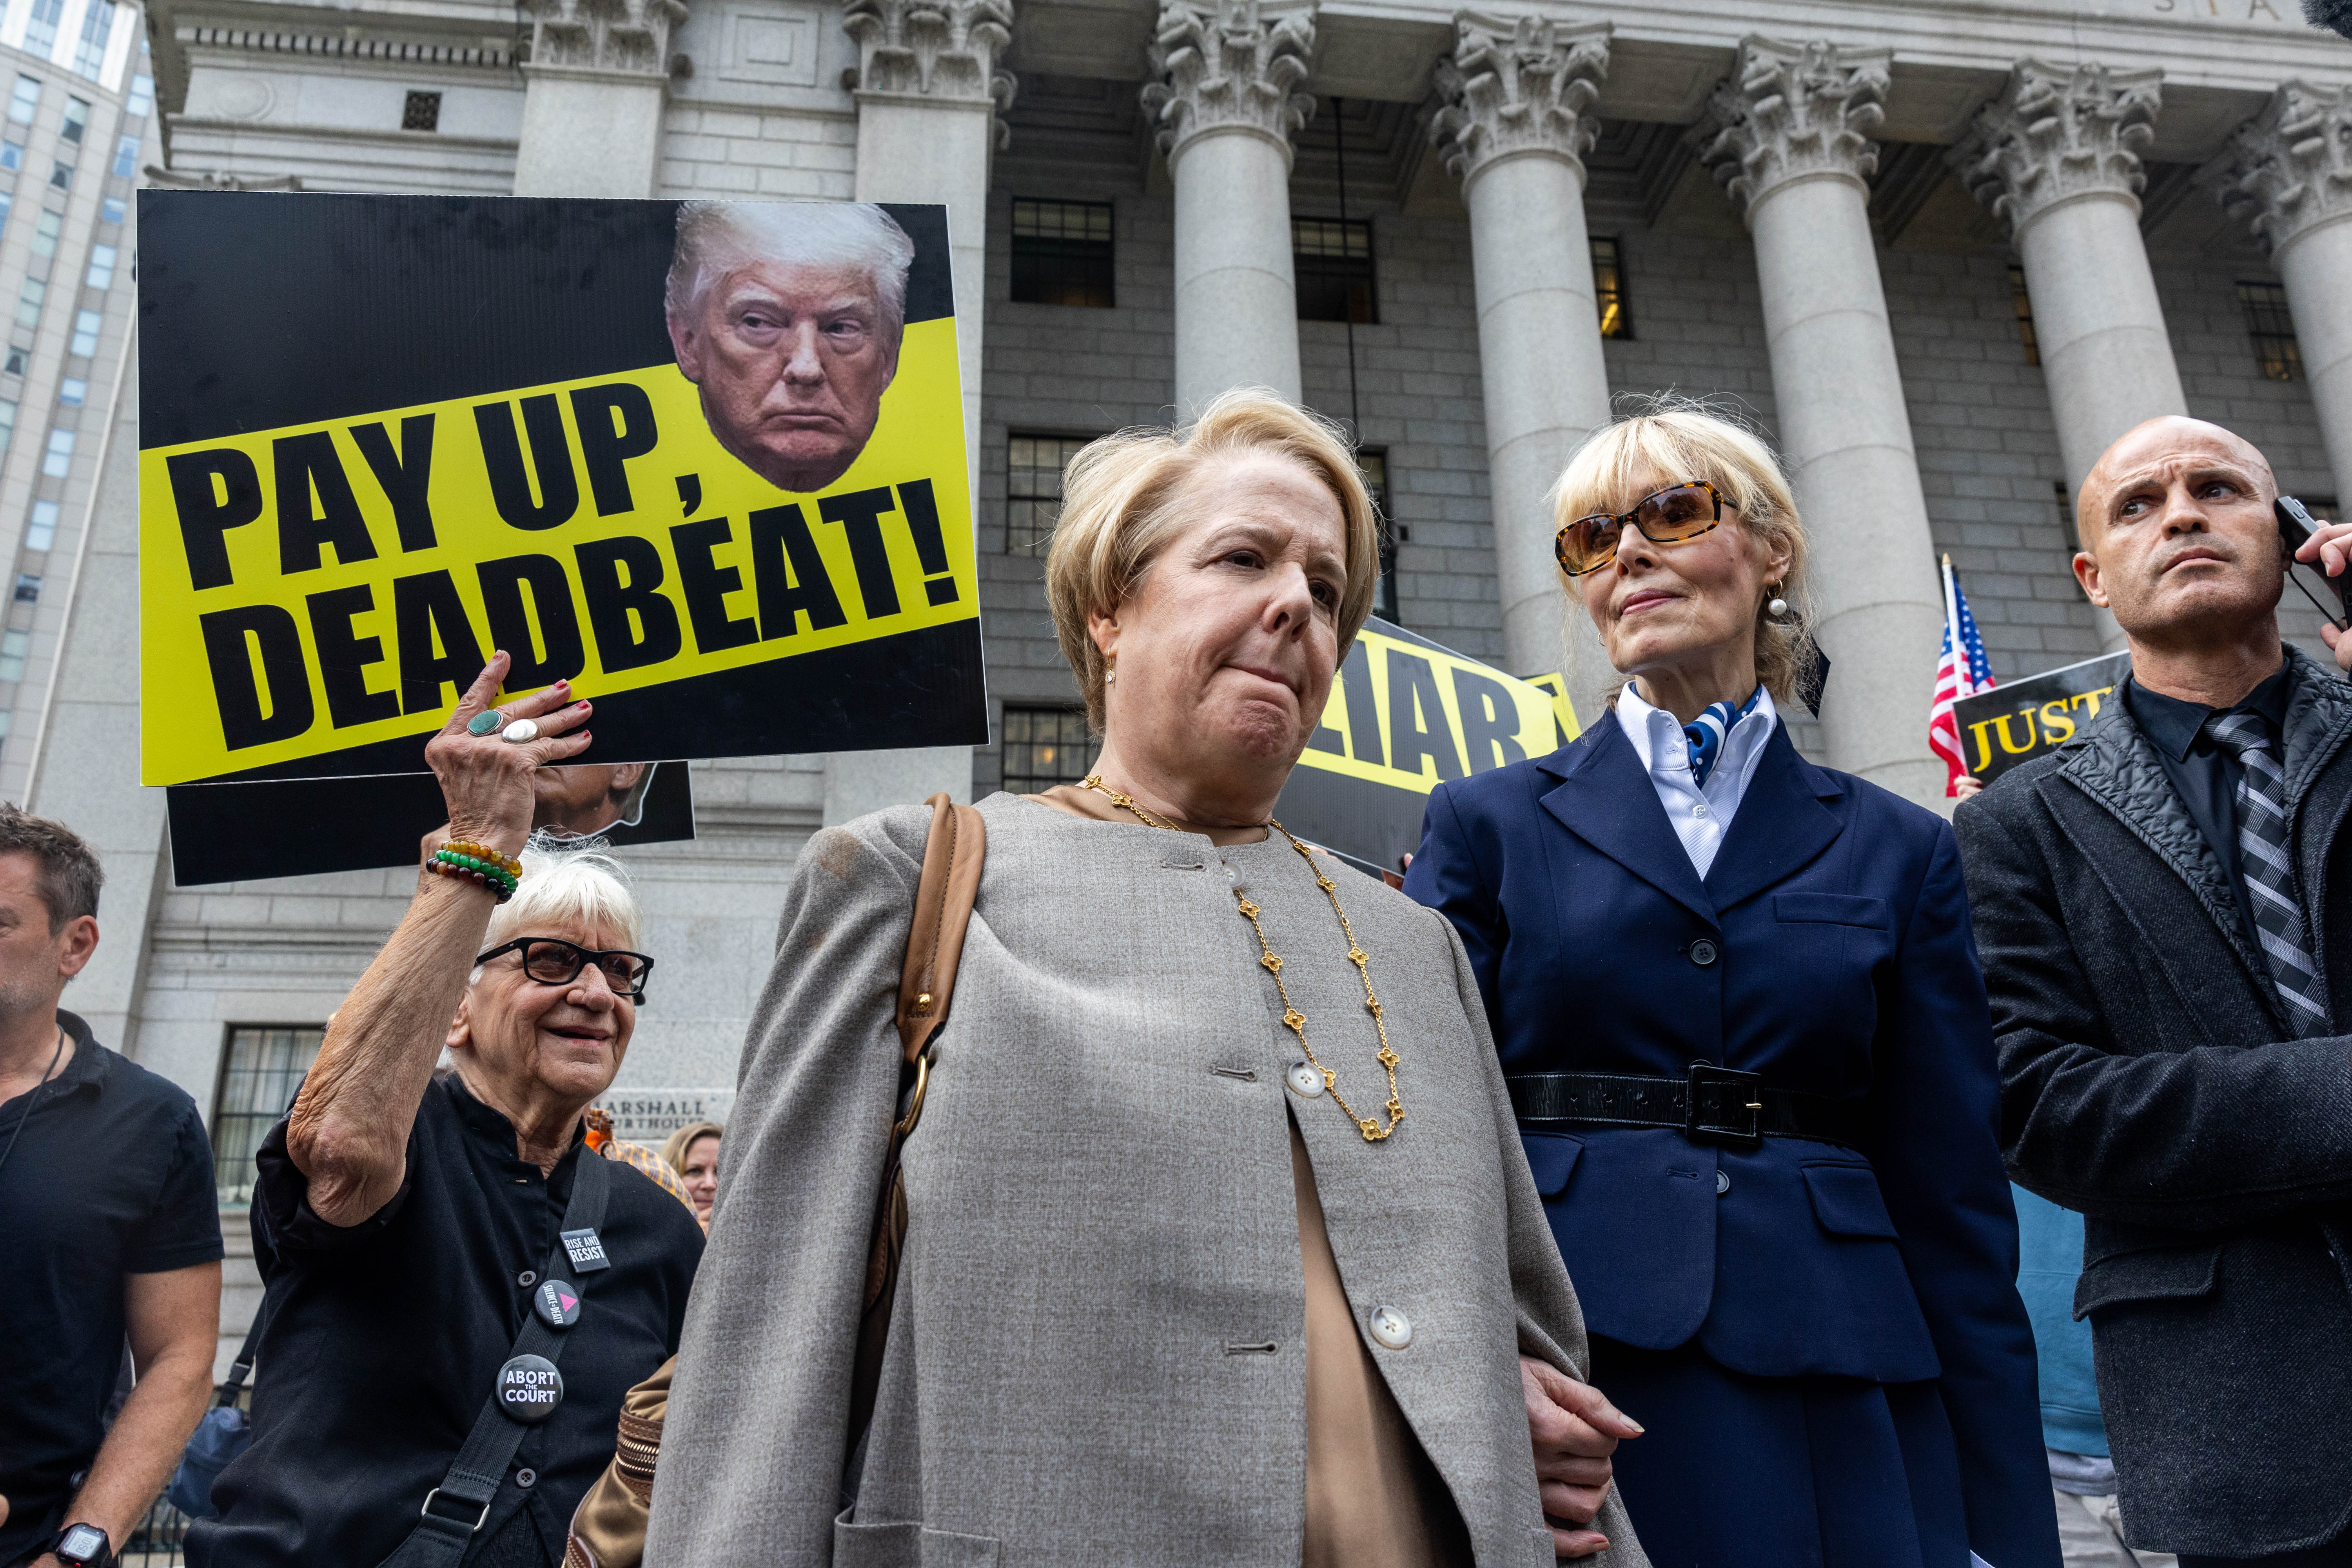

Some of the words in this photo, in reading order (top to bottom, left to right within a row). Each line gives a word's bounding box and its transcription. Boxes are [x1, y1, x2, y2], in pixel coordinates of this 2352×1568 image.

[165, 413, 438, 591] PAY
[473, 383, 702, 531] UP,
[199, 477, 960, 751] DEADBEAT!
[1306, 639, 1528, 778] IAR
[593, 1100, 705, 1115] ARSHALL
[564, 1238, 584, 1250] RISE
[583, 1236, 600, 1247] AND
[569, 1245, 605, 1263] RESIST
[506, 1370, 555, 1385] ABORT
[506, 1389, 556, 1403] COURT
